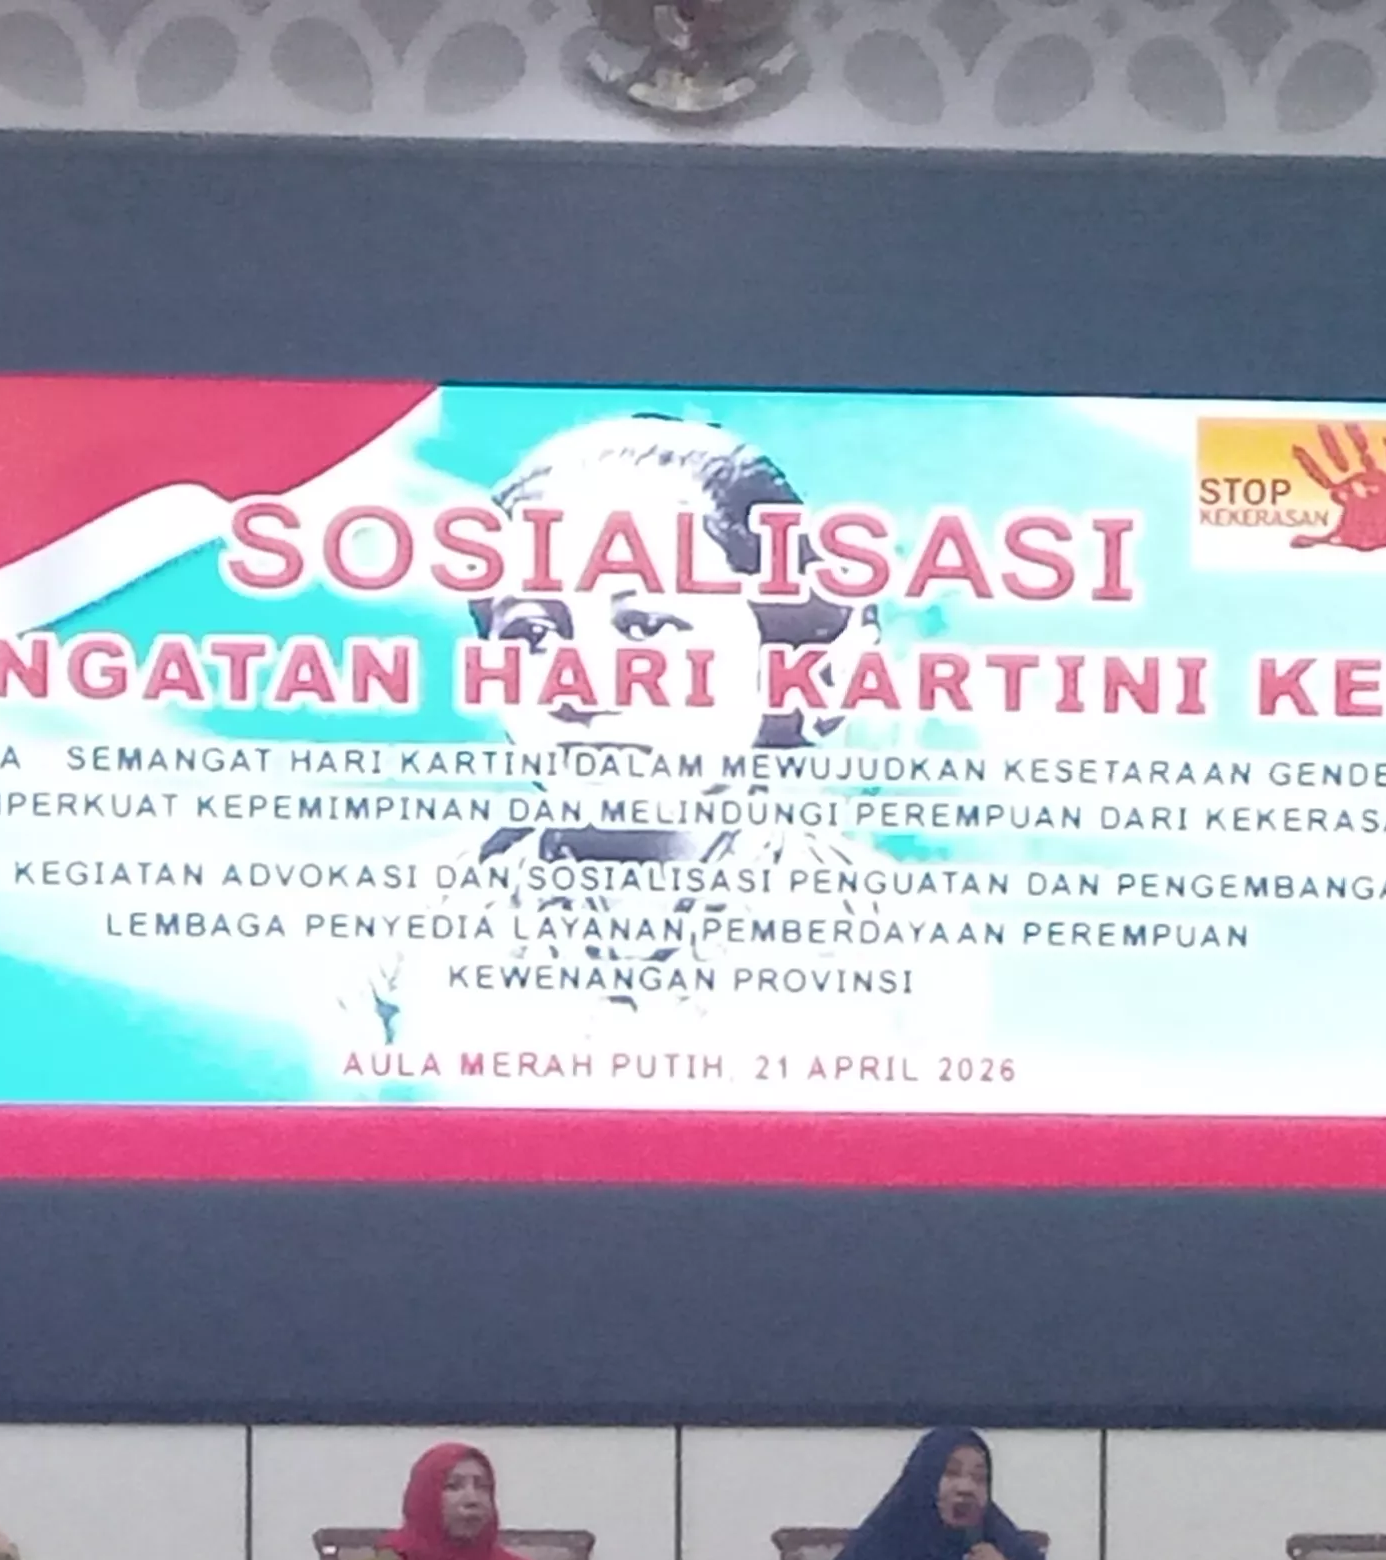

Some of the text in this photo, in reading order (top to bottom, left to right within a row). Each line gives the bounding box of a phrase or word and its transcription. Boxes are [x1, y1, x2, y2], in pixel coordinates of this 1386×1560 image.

[1199, 478, 1291, 505] STOP
[1199, 508, 1329, 527] KEKERASAN
[228, 503, 1133, 600] SOSIALISASI
[465, 645, 715, 708] HARI
[767, 650, 1208, 715] KARTINI
[66, 746, 272, 772] SEMANGAT
[290, 749, 381, 774] HARI
[400, 750, 558, 776] KARTINI
[576, 752, 703, 778] DALAM
[722, 754, 985, 781] MEWUJUDKAN
[1004, 757, 1251, 785] KESETARAAN
[197, 795, 491, 821] KEPEMIMPINAN
[510, 799, 581, 822] DAN
[600, 800, 838, 827] MELINDUNGI
[856, 802, 1081, 829] PEREMPUAN
[1101, 806, 1187, 831] DARI
[15, 861, 203, 887] KEGIATAN
[222, 863, 417, 889] ADVOKASI
[436, 865, 509, 888] DAN
[528, 866, 770, 892] SOSIALISASI
[790, 869, 1008, 895] PENGUATAN
[1028, 872, 1099, 896] DAN
[107, 912, 1248, 948] LEMBAGA PENYEDIA LAYANAN PEMBERDAYAAN PEREMPUAN
[449, 965, 912, 994] KEWENANGAN PROVINSI
[343, 1052, 441, 1077] AULA
[461, 1052, 592, 1078] MERAH
[754, 1055, 787, 1080] 21
[807, 1055, 918, 1082] APRIL
[939, 1056, 1015, 1082] 2026
